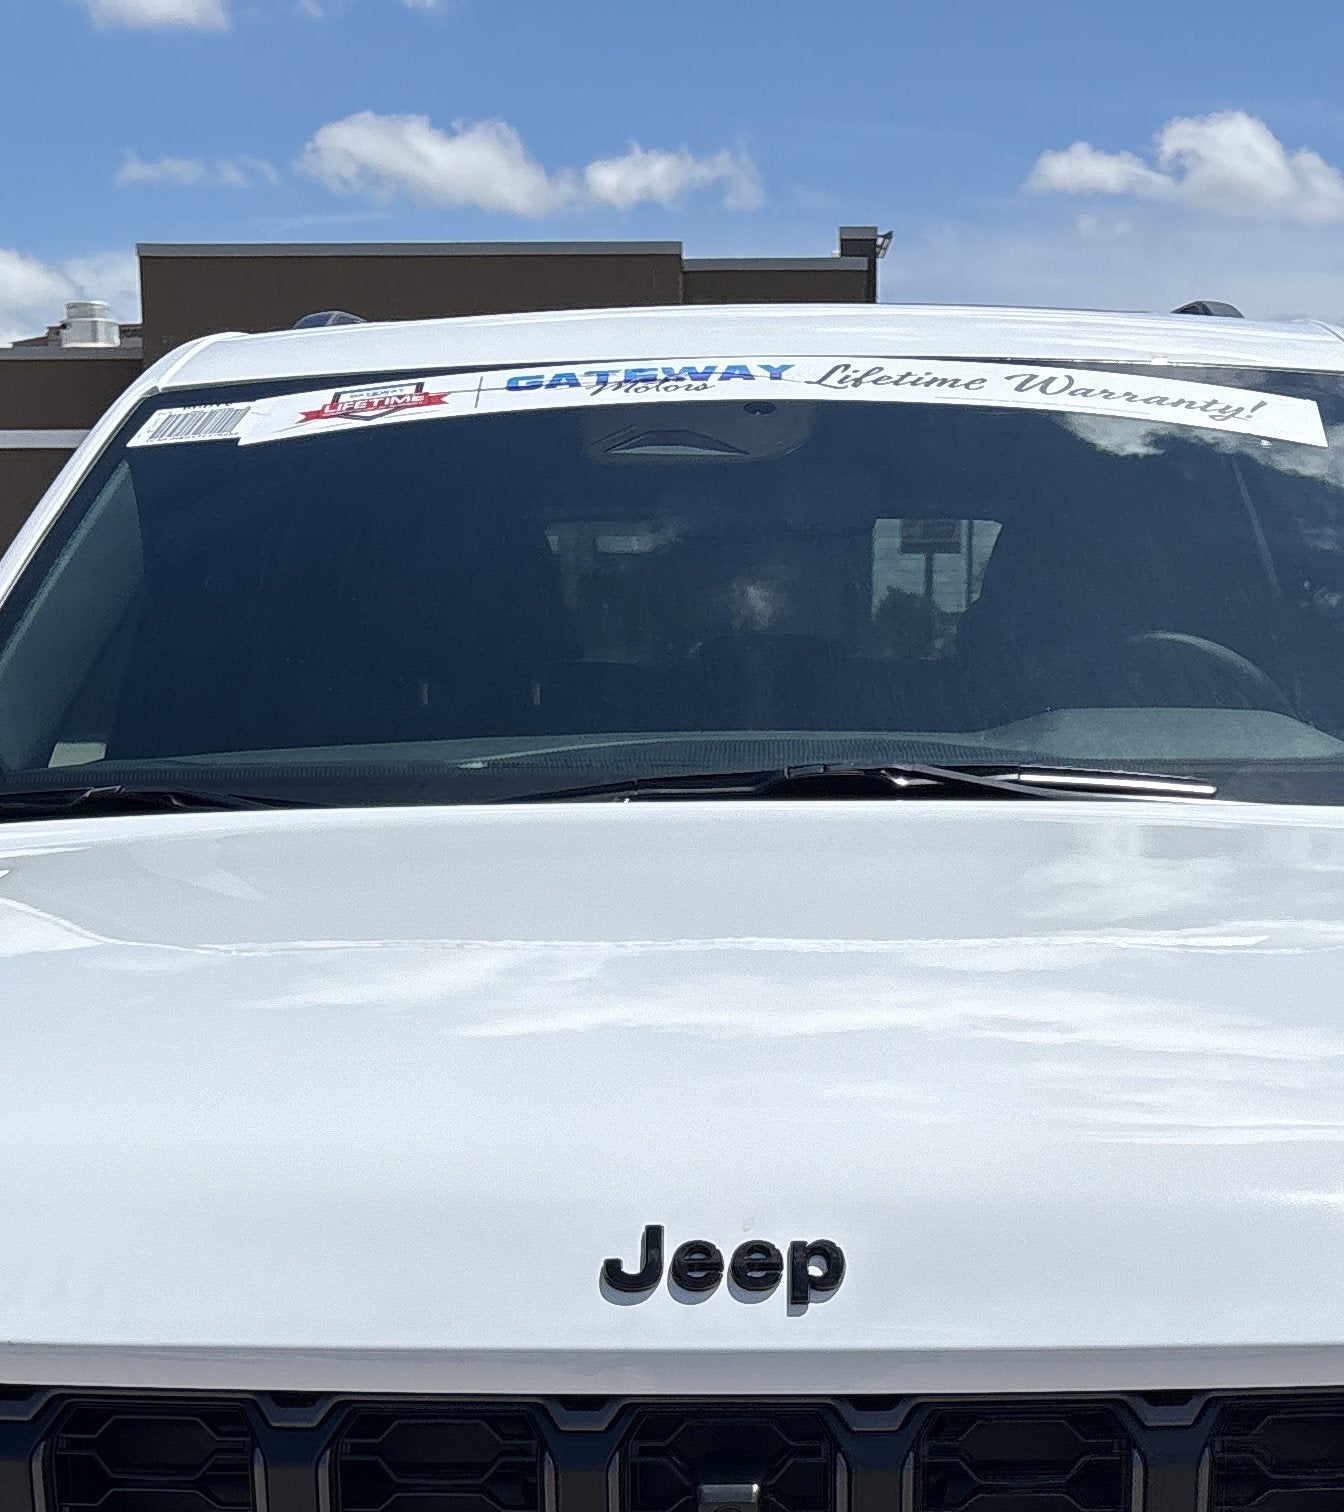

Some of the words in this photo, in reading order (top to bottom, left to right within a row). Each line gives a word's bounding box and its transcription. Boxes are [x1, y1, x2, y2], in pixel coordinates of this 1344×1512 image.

[323, 394, 426, 414] LIFETIME
[505, 363, 796, 391] GATEWAY
[804, 363, 989, 391] Lifetime
[1005, 373, 1269, 422] Warranty!
[585, 377, 716, 396] Motors
[603, 1224, 847, 1306] Jeep
